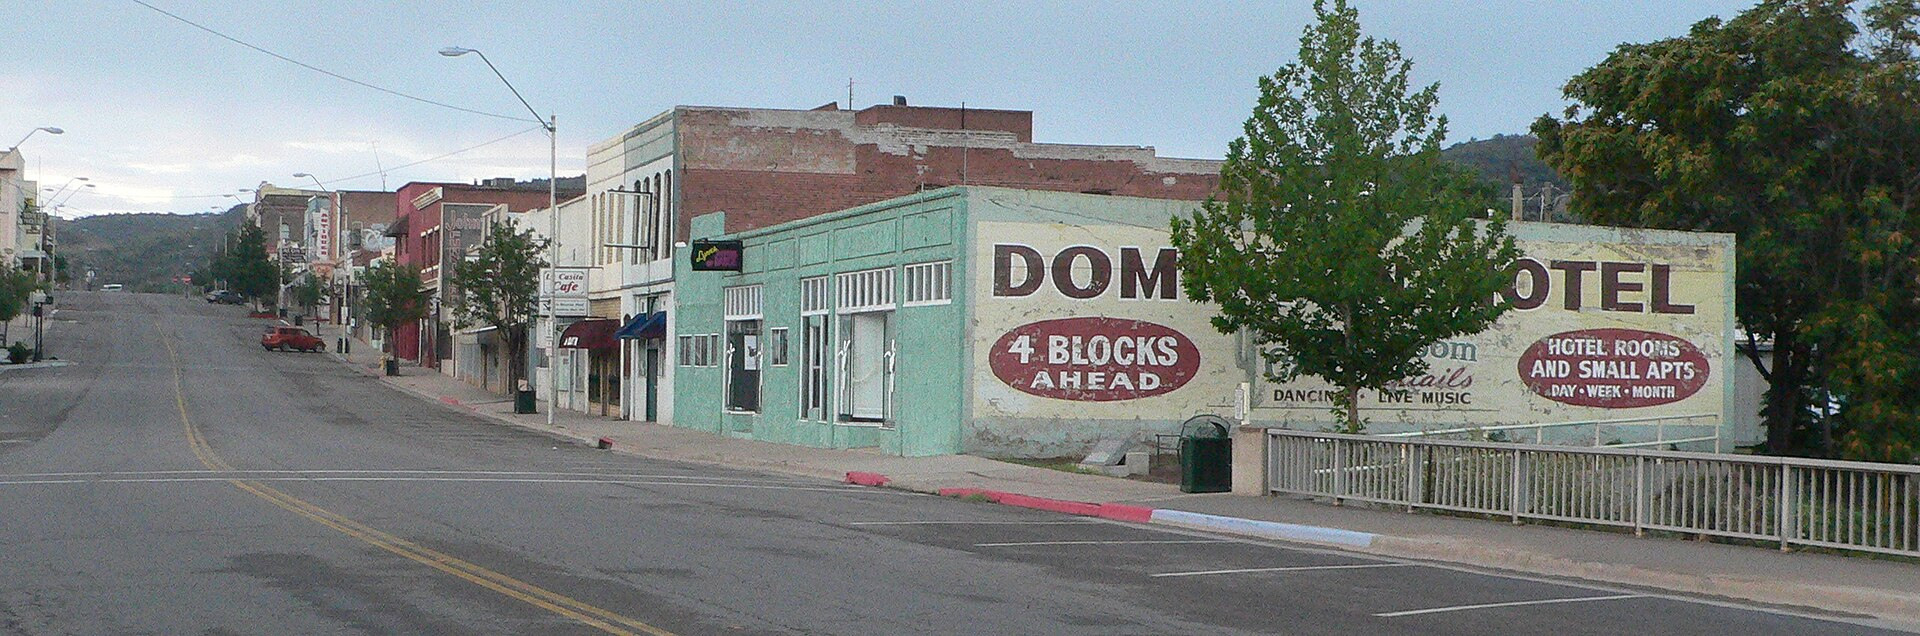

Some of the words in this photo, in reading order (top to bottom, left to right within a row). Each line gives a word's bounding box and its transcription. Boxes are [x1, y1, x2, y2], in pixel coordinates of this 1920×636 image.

[1495, 257, 1696, 315] OTEL
[1008, 335, 1034, 364] 4
[1049, 335, 1178, 366] BLOCKS
[1549, 338, 1607, 356] HOTEL
[1615, 339, 1680, 357] ROOMS
[1531, 360, 1570, 379] AND
[1579, 361, 1640, 379] SMALL
[1646, 361, 1695, 380] APTS
[1031, 371, 1160, 390] AHEAD
[1274, 389, 1335, 402] DANCIN
[1379, 392, 1413, 403] LIVE
[1422, 392, 1471, 404] MUSIC
[1552, 384, 1577, 397] DAY
[1587, 385, 1621, 398] WEEK
[1633, 386, 1675, 398] MONTH
